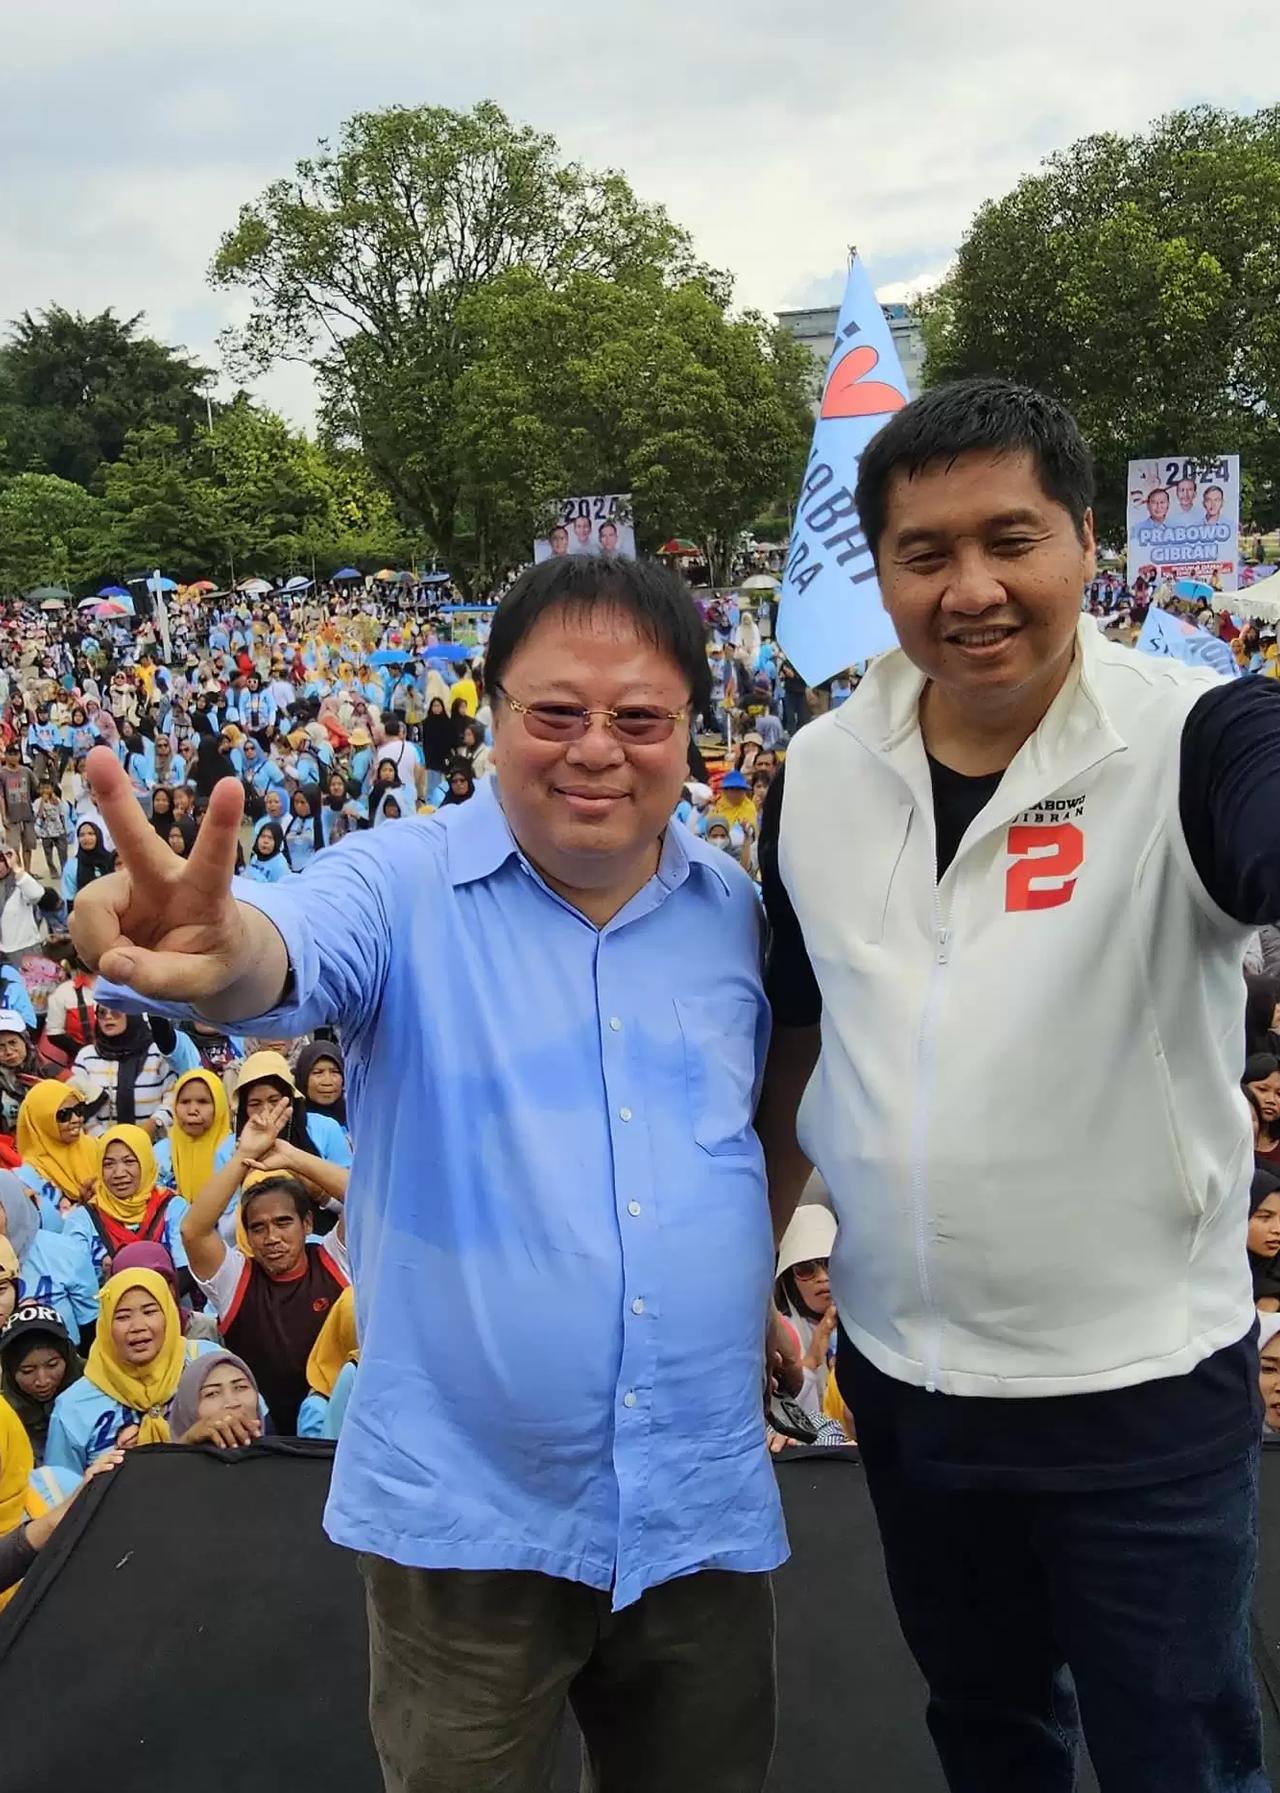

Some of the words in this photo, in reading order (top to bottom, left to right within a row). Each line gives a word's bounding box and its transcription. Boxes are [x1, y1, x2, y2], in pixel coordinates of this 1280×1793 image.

[1139, 523, 1232, 548] PRABOWO
[1150, 543, 1220, 564] GIBRAN
[1005, 822, 1086, 913] 2
[5, 1306, 64, 1333] PORT
